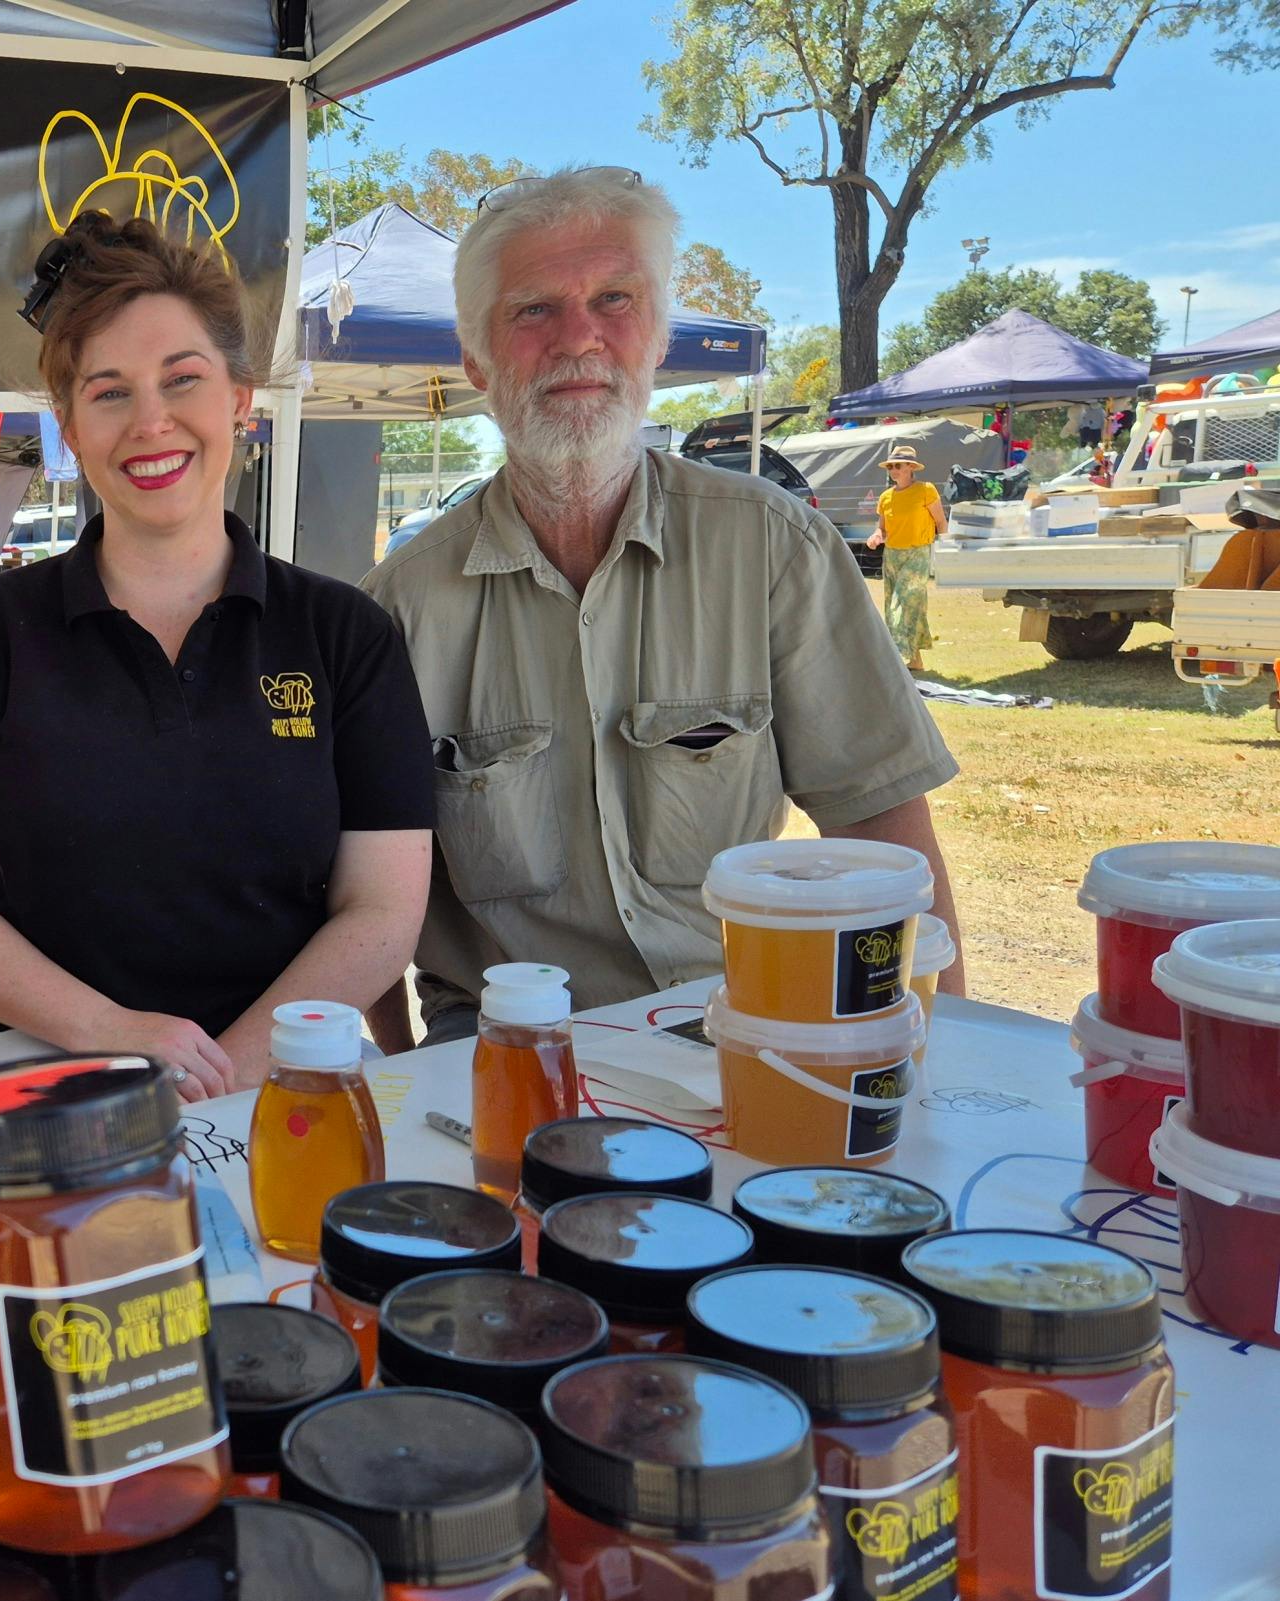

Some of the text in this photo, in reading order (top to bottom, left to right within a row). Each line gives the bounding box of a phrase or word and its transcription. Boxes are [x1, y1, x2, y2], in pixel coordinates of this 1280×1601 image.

[291, 724, 316, 738] HONEY
[115, 1299, 211, 1361] PURE HONEY
